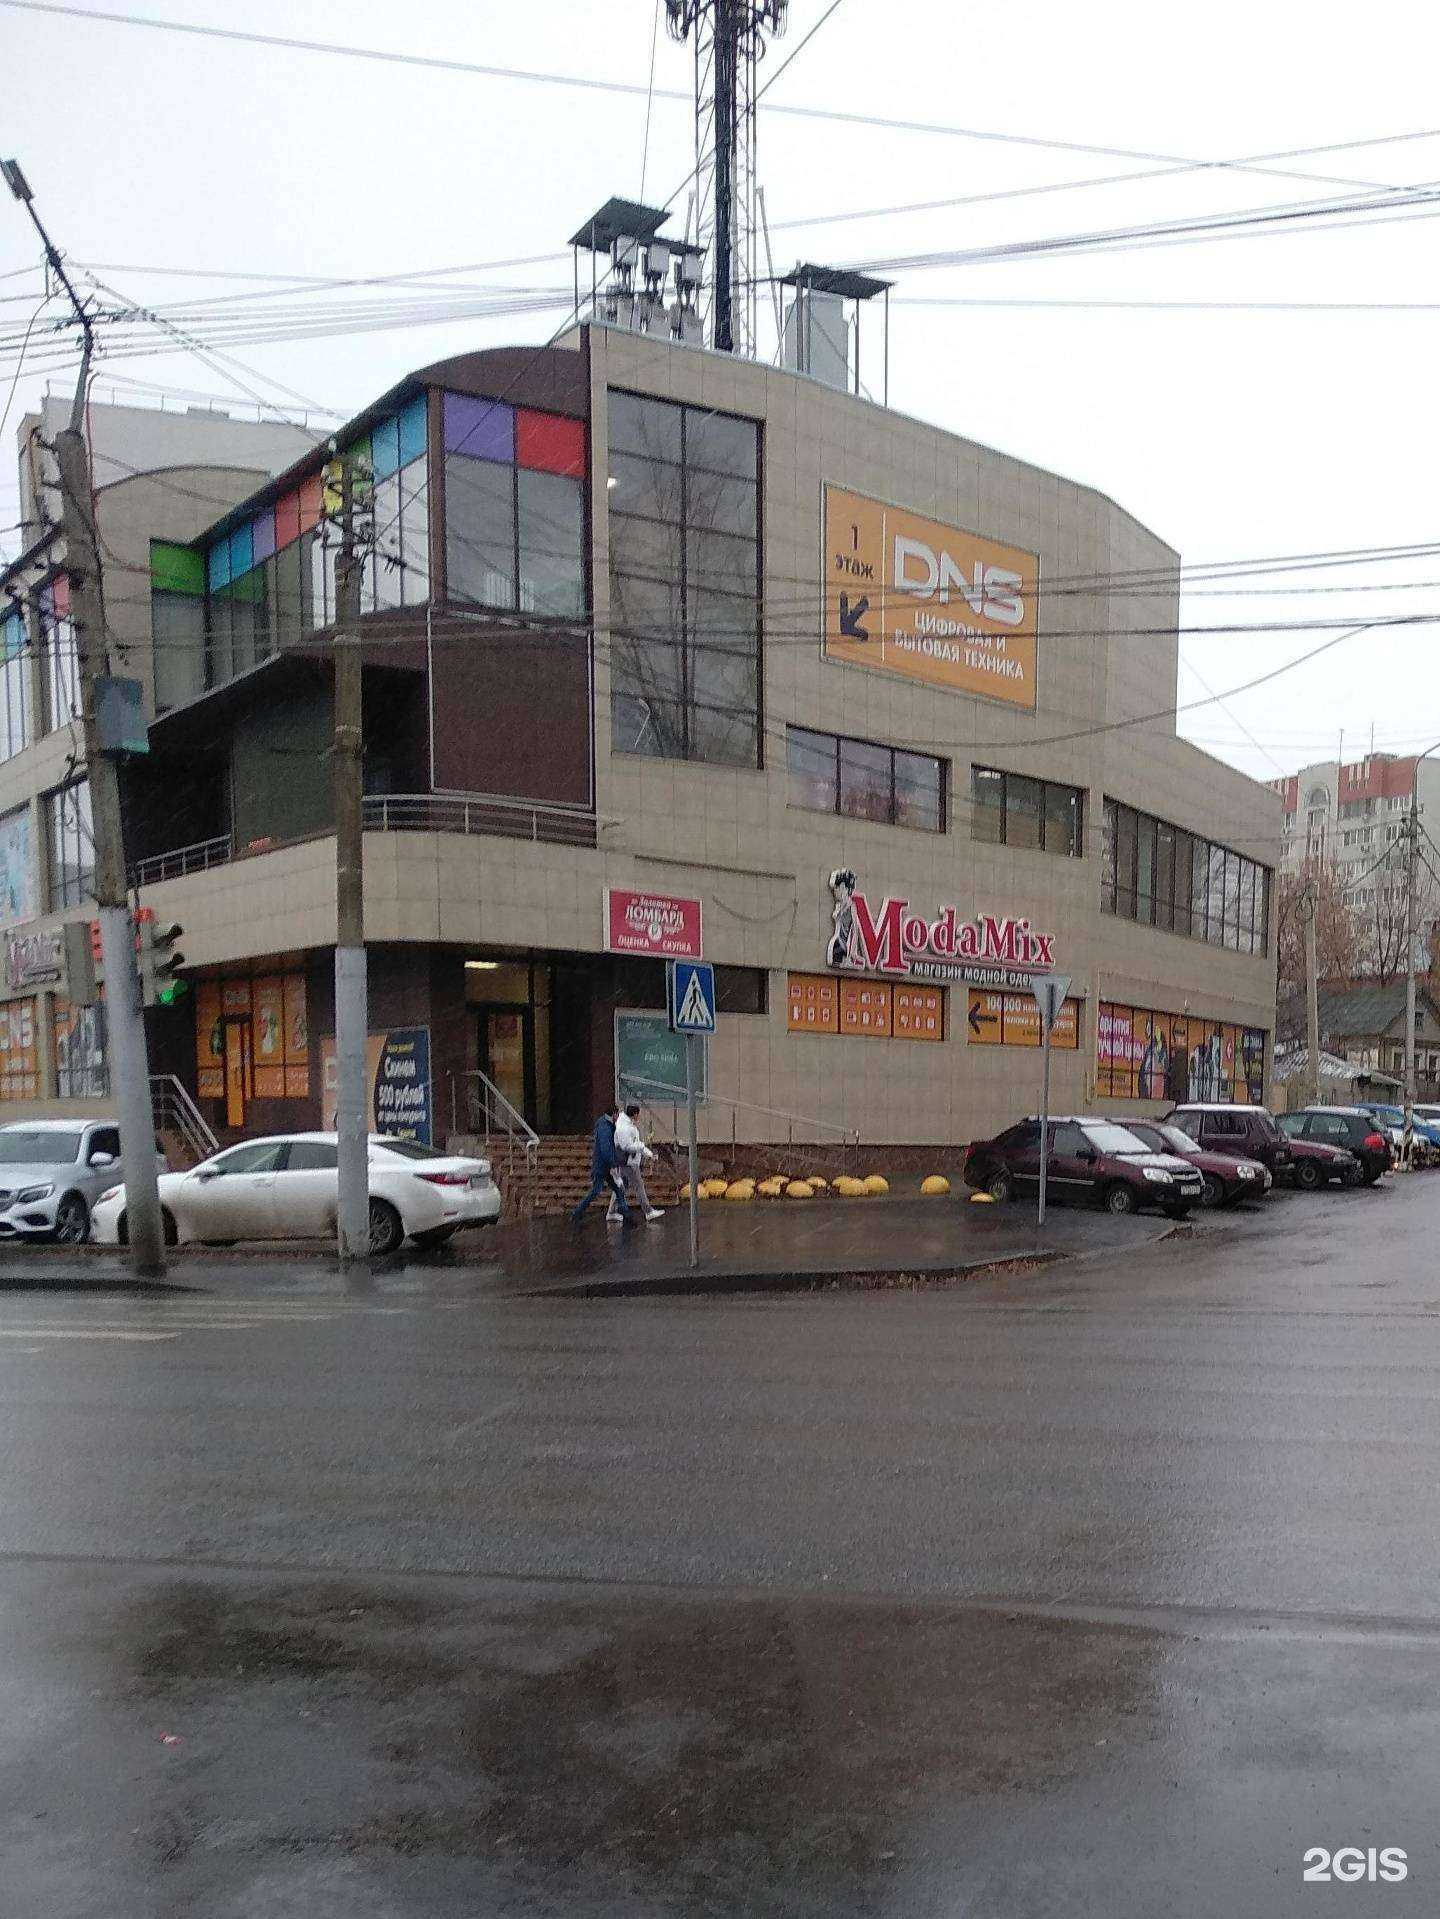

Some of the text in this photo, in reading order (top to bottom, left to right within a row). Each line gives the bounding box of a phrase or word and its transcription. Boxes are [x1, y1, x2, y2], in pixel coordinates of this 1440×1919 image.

[851, 523, 858, 550] 1
[895, 534, 1025, 627] DNS
[996, 635, 1006, 653] И
[964, 648, 1025, 680] ТЕХНИКА
[625, 904, 685, 931] ЛОМБАРД
[849, 890, 1056, 971] ModaMix
[617, 934, 692, 953] ОЦЕНКА СКУПКА
[914, 961, 961, 980] магазин
[964, 967, 1007, 984] модной
